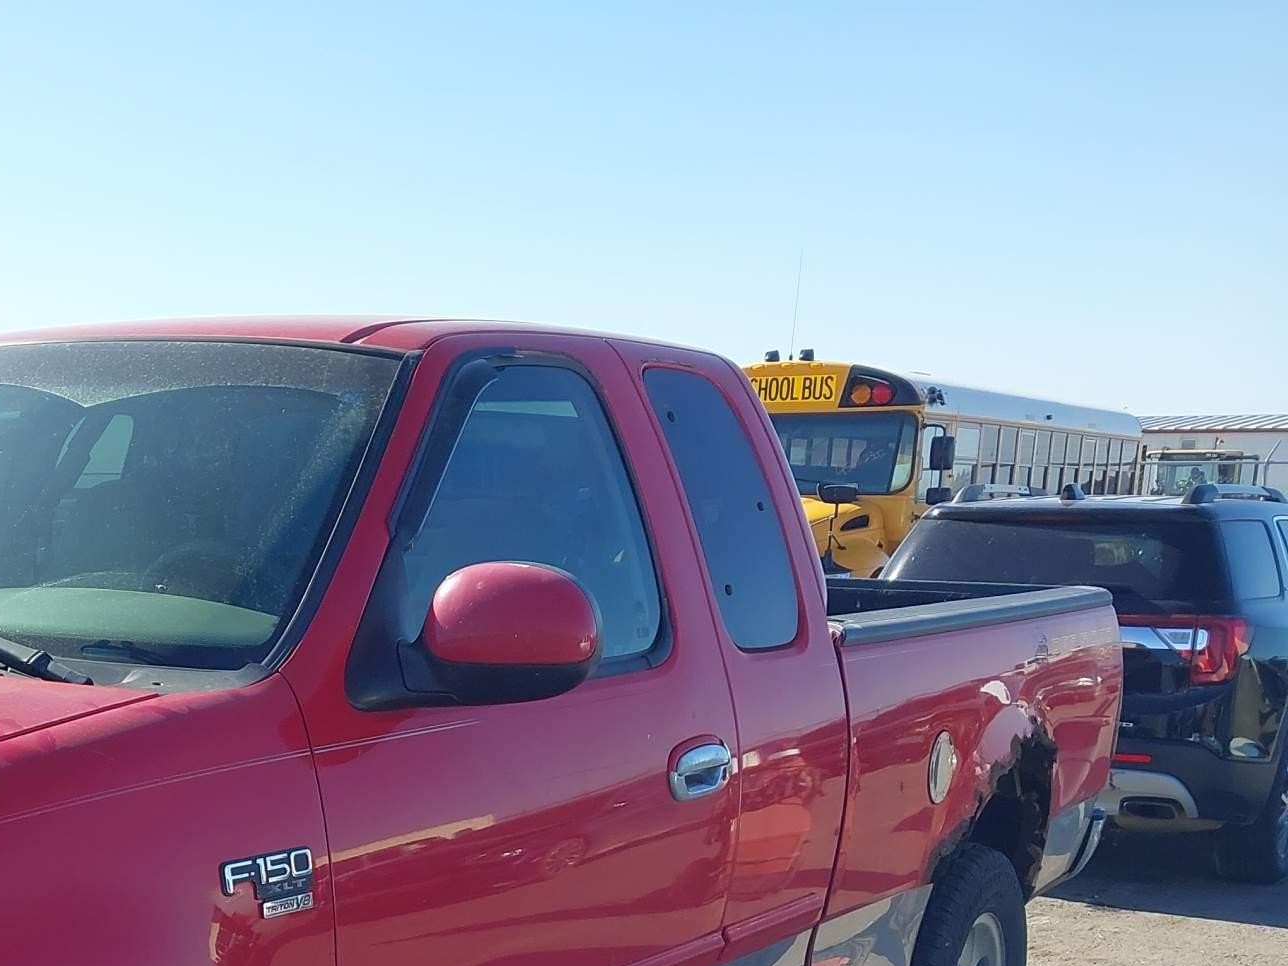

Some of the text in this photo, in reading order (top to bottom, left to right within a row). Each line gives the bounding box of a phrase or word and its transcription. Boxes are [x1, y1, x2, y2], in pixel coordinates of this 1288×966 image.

[802, 375, 834, 400] BUS
[269, 878, 307, 894] XLT
[266, 894, 311, 913] TRITON V8
